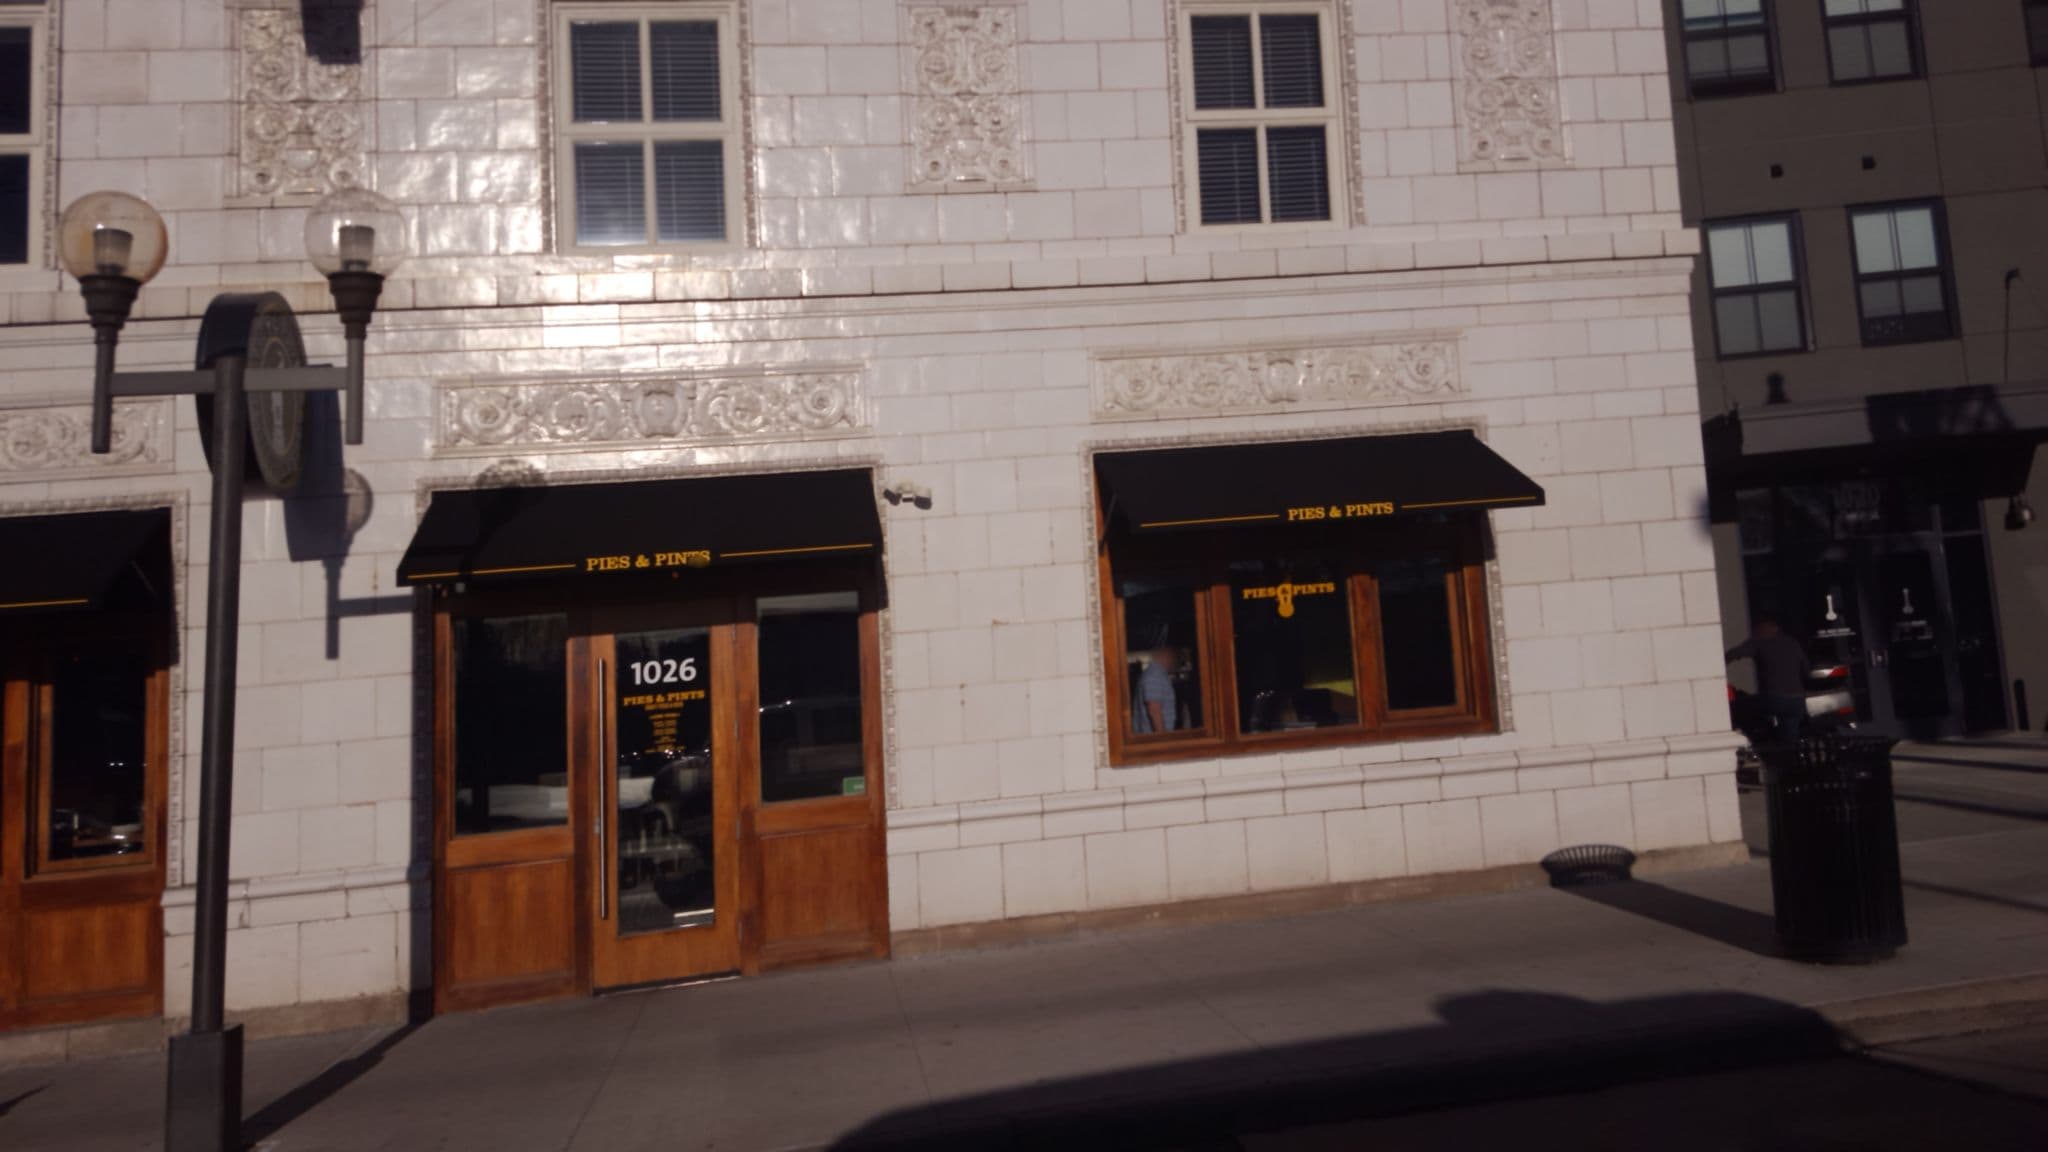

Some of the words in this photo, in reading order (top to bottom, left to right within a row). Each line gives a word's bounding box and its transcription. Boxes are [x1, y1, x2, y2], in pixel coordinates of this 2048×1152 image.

[1287, 507, 1326, 521] PIES
[1329, 506, 1341, 518] &
[1346, 502, 1394, 517] PINTS
[586, 555, 631, 571] PIES
[635, 554, 650, 568] &
[1243, 587, 1277, 600] PIES
[1292, 582, 1335, 596] PINTS
[630, 657, 697, 686] 1026
[623, 695, 653, 706] PIES
[667, 690, 705, 702] PINTS
